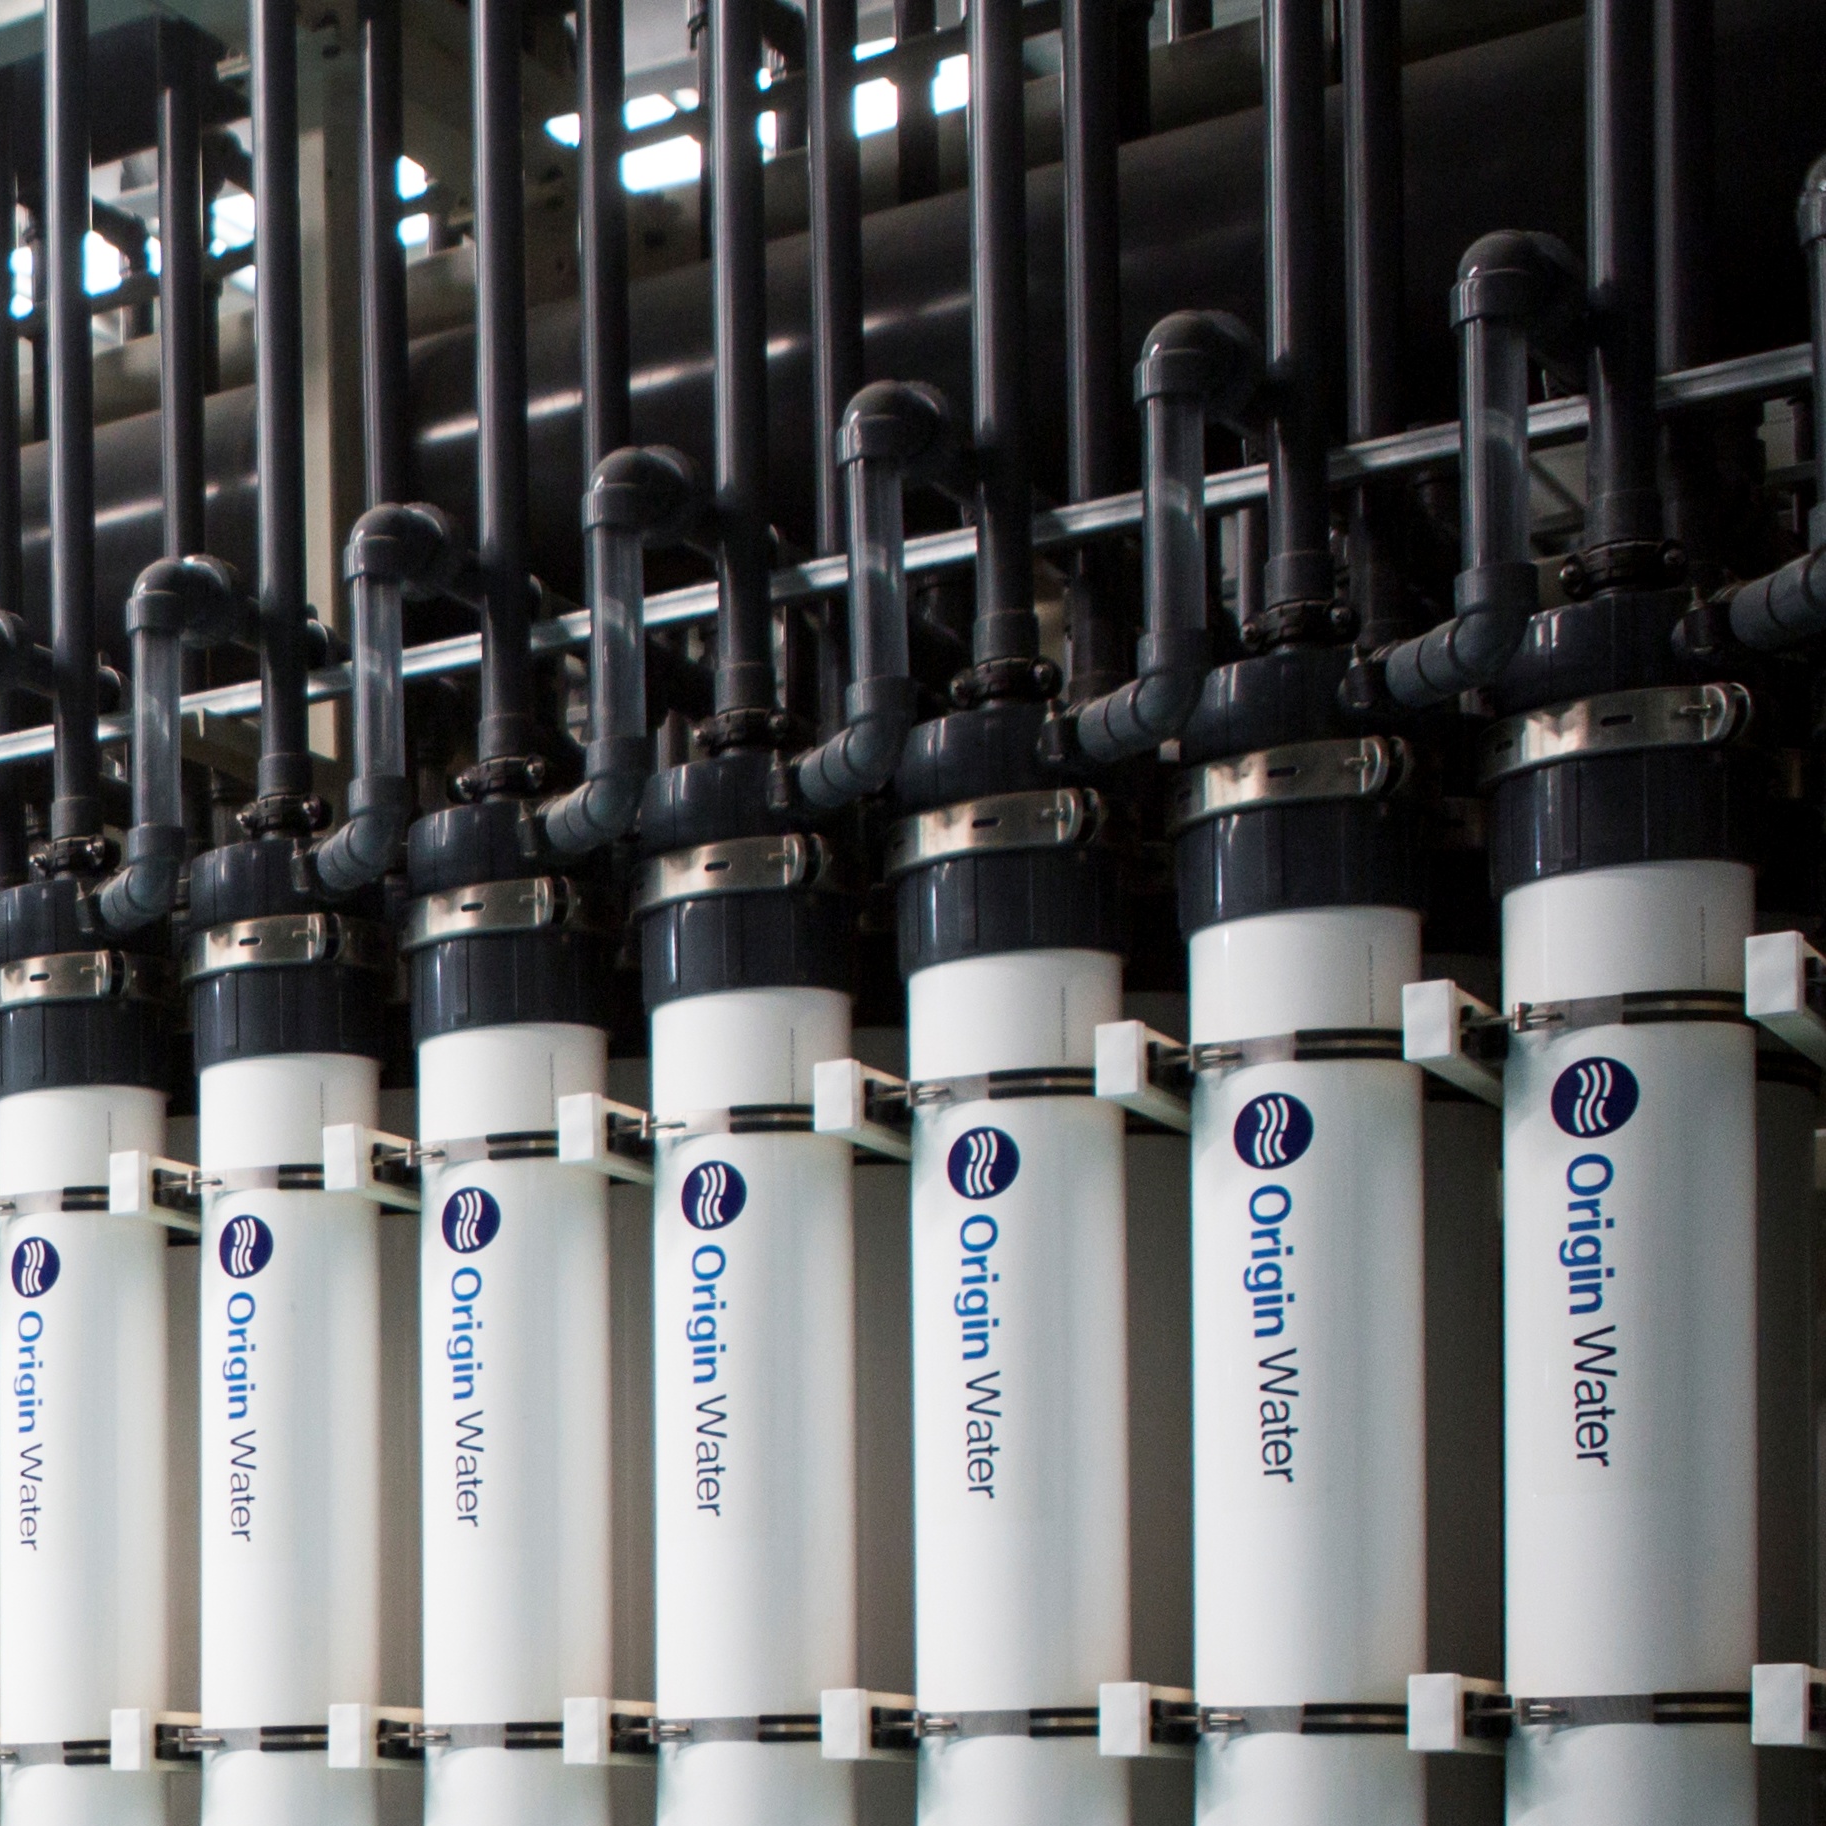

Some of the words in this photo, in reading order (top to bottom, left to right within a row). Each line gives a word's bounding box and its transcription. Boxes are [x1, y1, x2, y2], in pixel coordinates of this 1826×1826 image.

[955, 1214, 999, 1360] Origin
[1244, 1185, 1295, 1337] Origin
[1560, 1154, 1615, 1314] Origin
[15, 1311, 43, 1432] Origin
[224, 1292, 255, 1419] Origin
[448, 1267, 482, 1399] Origin
[687, 1245, 726, 1383] Origin
[696, 1394, 727, 1516] Water
[966, 1370, 1002, 1499] Water
[1259, 1348, 1299, 1482] Water
[1574, 1325, 1618, 1467] Water
[21, 1443, 43, 1550] Water
[231, 1430, 256, 1541] Water
[456, 1410, 484, 1527] Water
